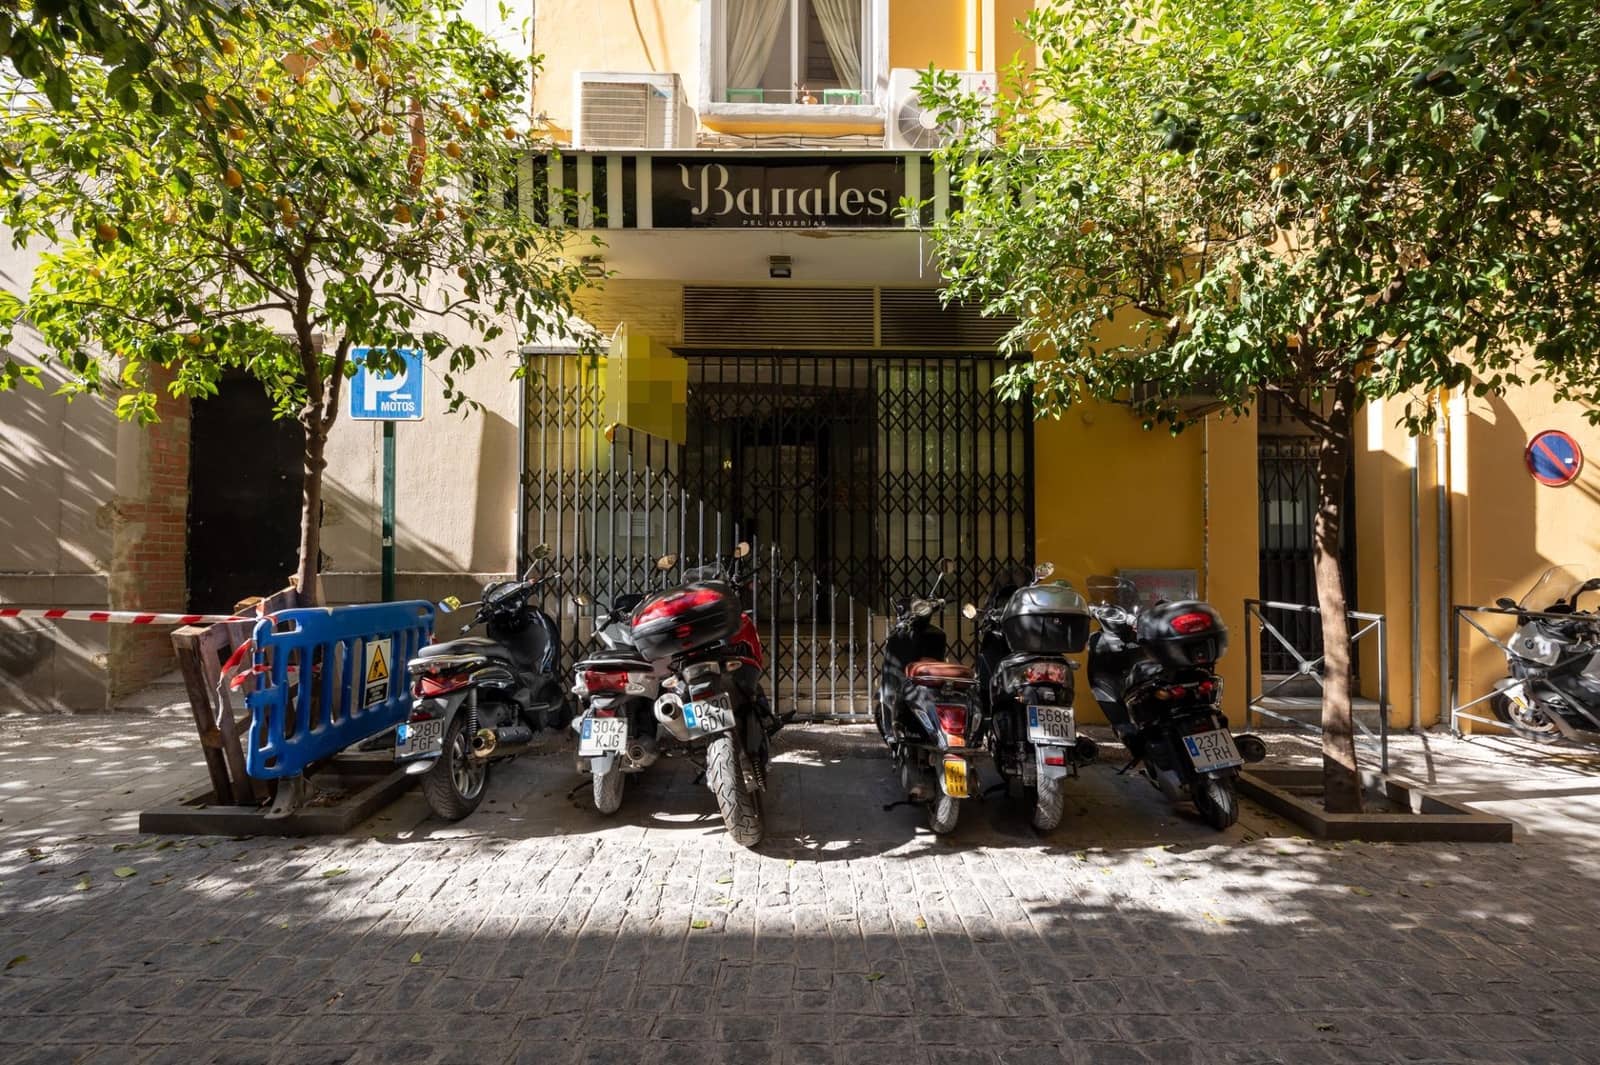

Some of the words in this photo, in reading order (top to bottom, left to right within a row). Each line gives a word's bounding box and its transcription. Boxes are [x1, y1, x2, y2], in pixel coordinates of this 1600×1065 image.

[677, 163, 888, 217] Barrales
[364, 354, 408, 411] P
[381, 401, 415, 412] MOTOS
[701, 712, 726, 732] GDV
[1038, 709, 1071, 723] 5688
[593, 720, 625, 734] 3042
[1043, 723, 1069, 737] HGN
[410, 735, 436, 752] FGF
[595, 734, 620, 748] KJG
[1195, 731, 1229, 750] 2371
[1204, 746, 1233, 762] FRH
